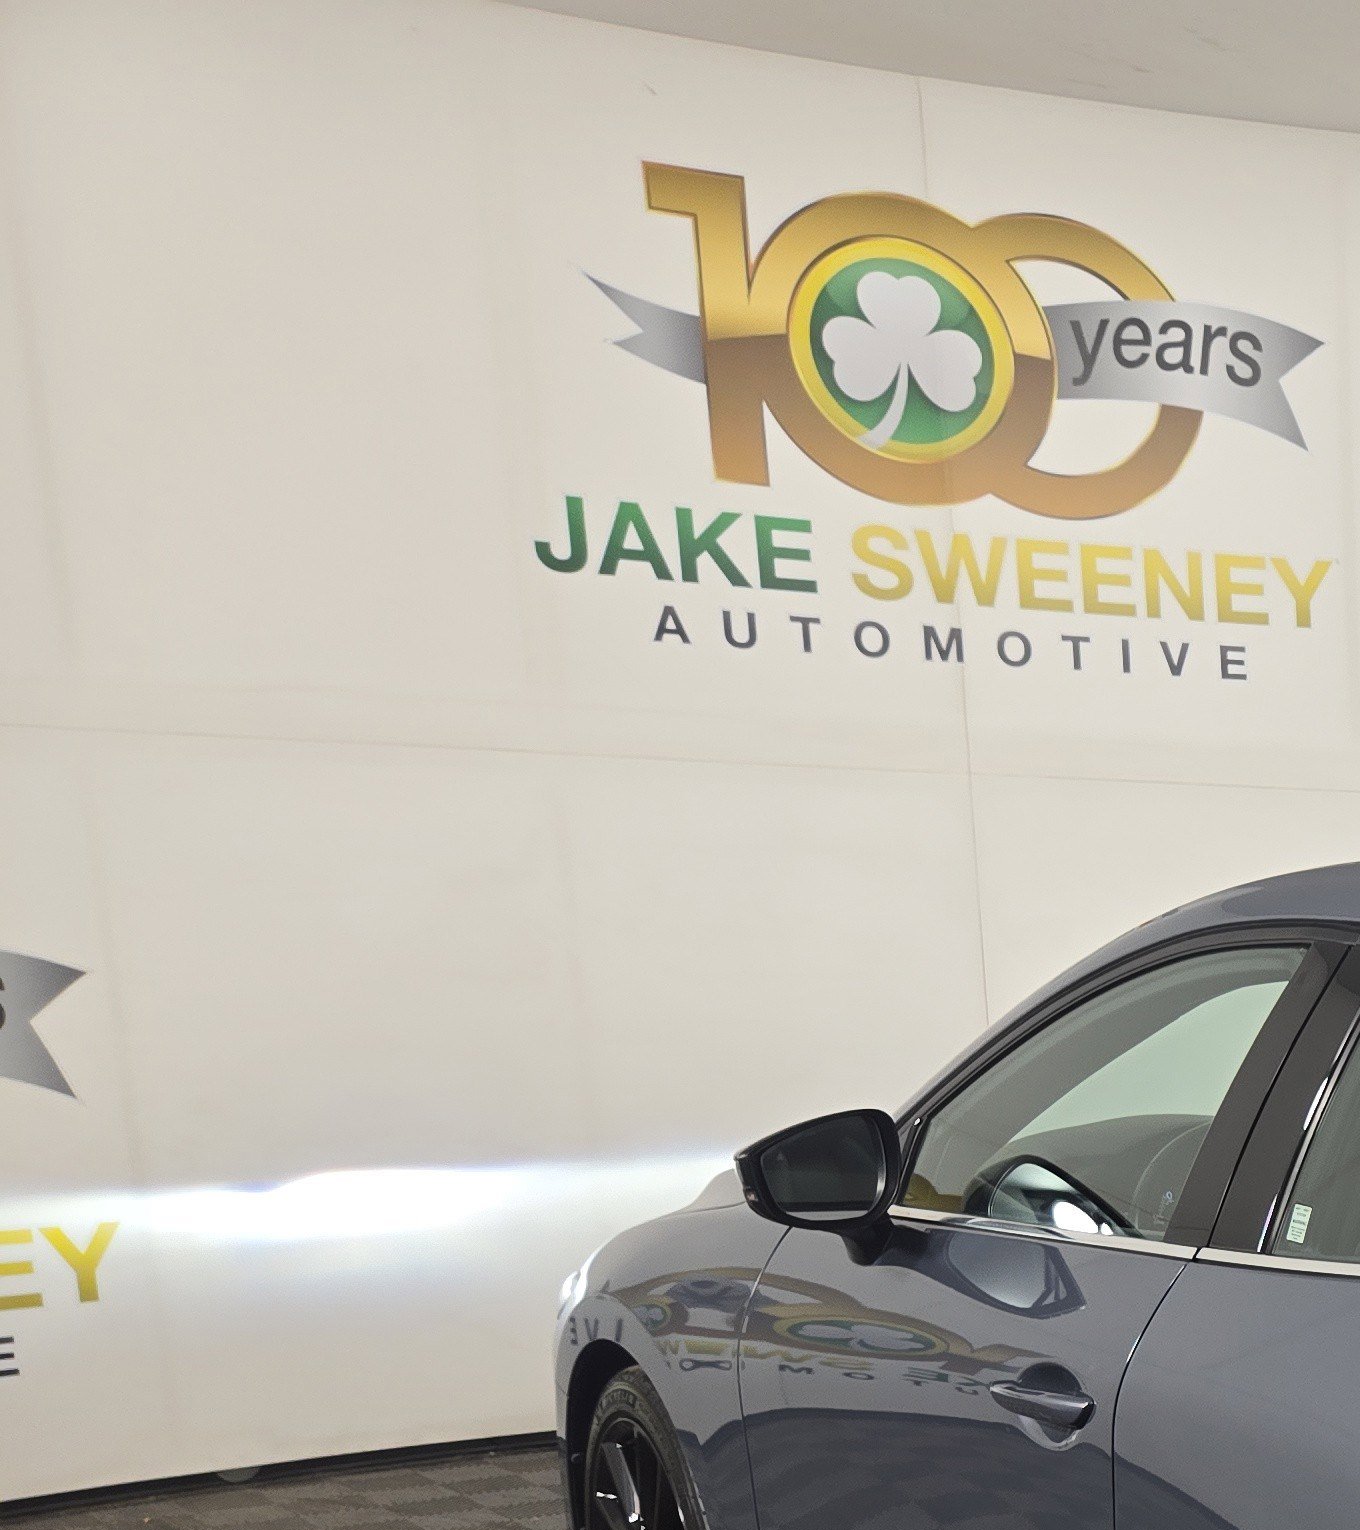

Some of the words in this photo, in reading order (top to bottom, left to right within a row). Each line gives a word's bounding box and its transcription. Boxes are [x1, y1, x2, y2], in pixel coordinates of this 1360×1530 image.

[1069, 313, 1265, 388] years
[533, 493, 819, 595] JAKE
[849, 523, 1332, 630] SWEENEY
[653, 604, 1248, 681] AUTOMOTIVE
